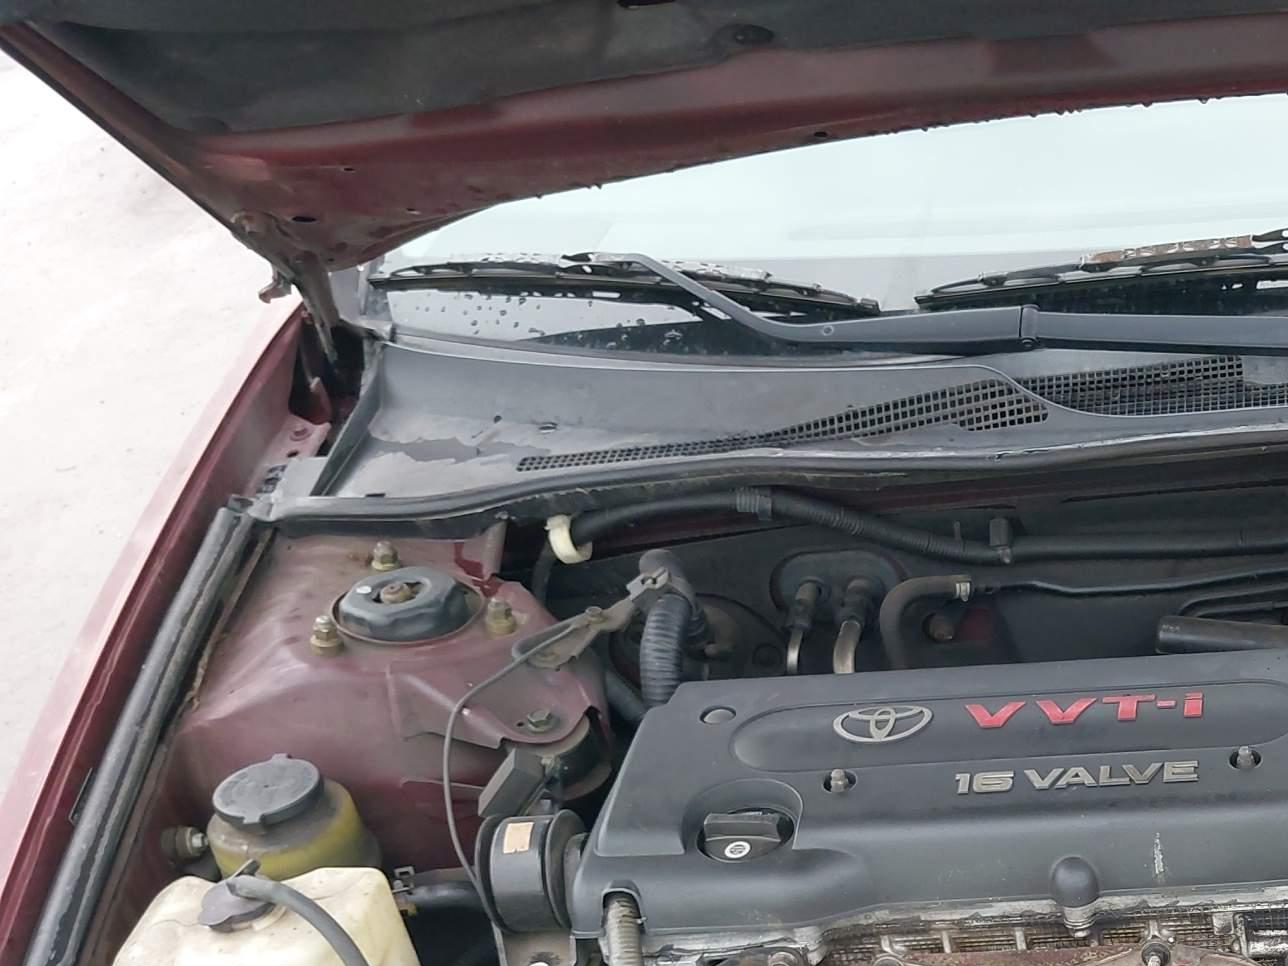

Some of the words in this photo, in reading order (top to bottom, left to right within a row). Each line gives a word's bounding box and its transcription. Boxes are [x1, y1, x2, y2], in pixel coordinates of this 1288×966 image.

[964, 691, 1204, 729] VVT-i
[955, 769, 1015, 795] 16
[1023, 759, 1200, 791] VALVE
